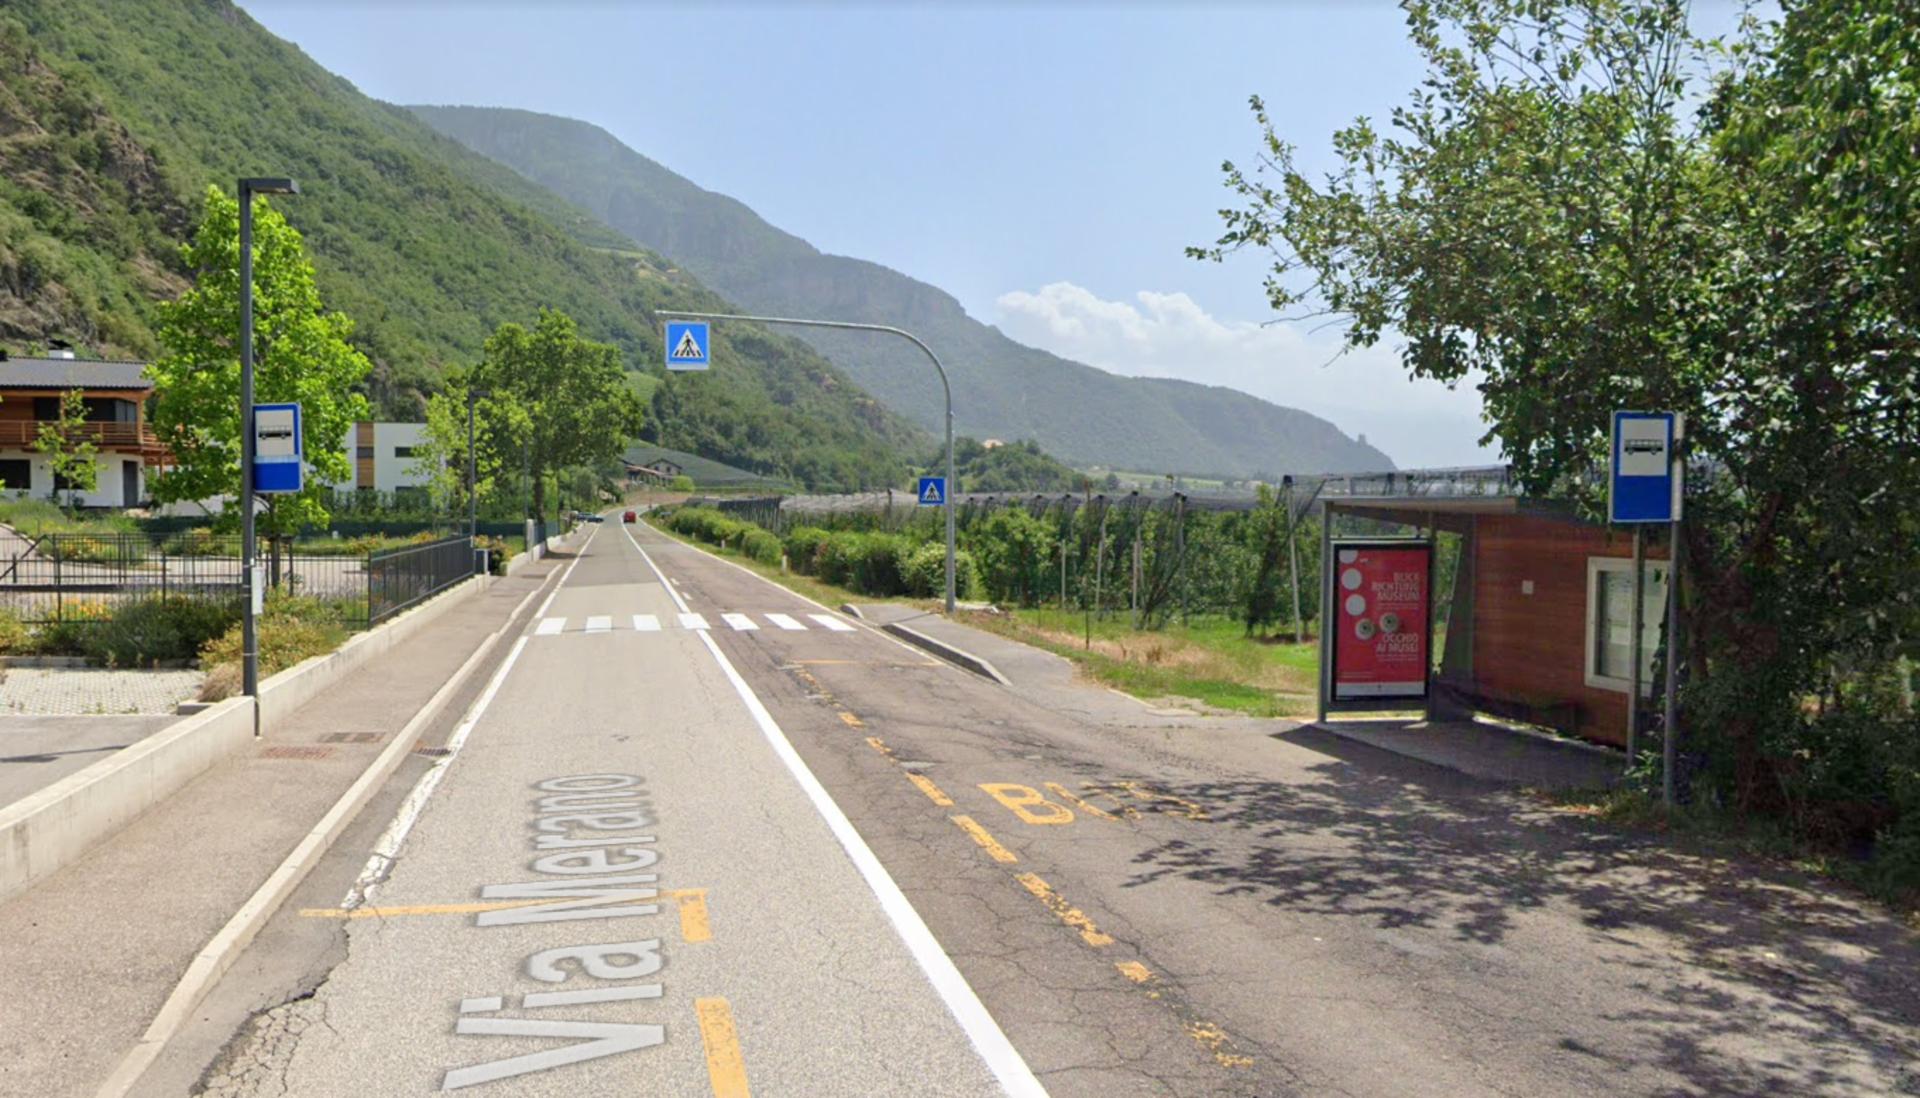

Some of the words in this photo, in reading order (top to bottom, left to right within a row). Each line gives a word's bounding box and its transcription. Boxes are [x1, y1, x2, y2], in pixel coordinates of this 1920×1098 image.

[1376, 591, 1419, 601] MUSEUM
[1383, 632, 1419, 642] OCCHIO
[1388, 642, 1418, 652] MUSEI
